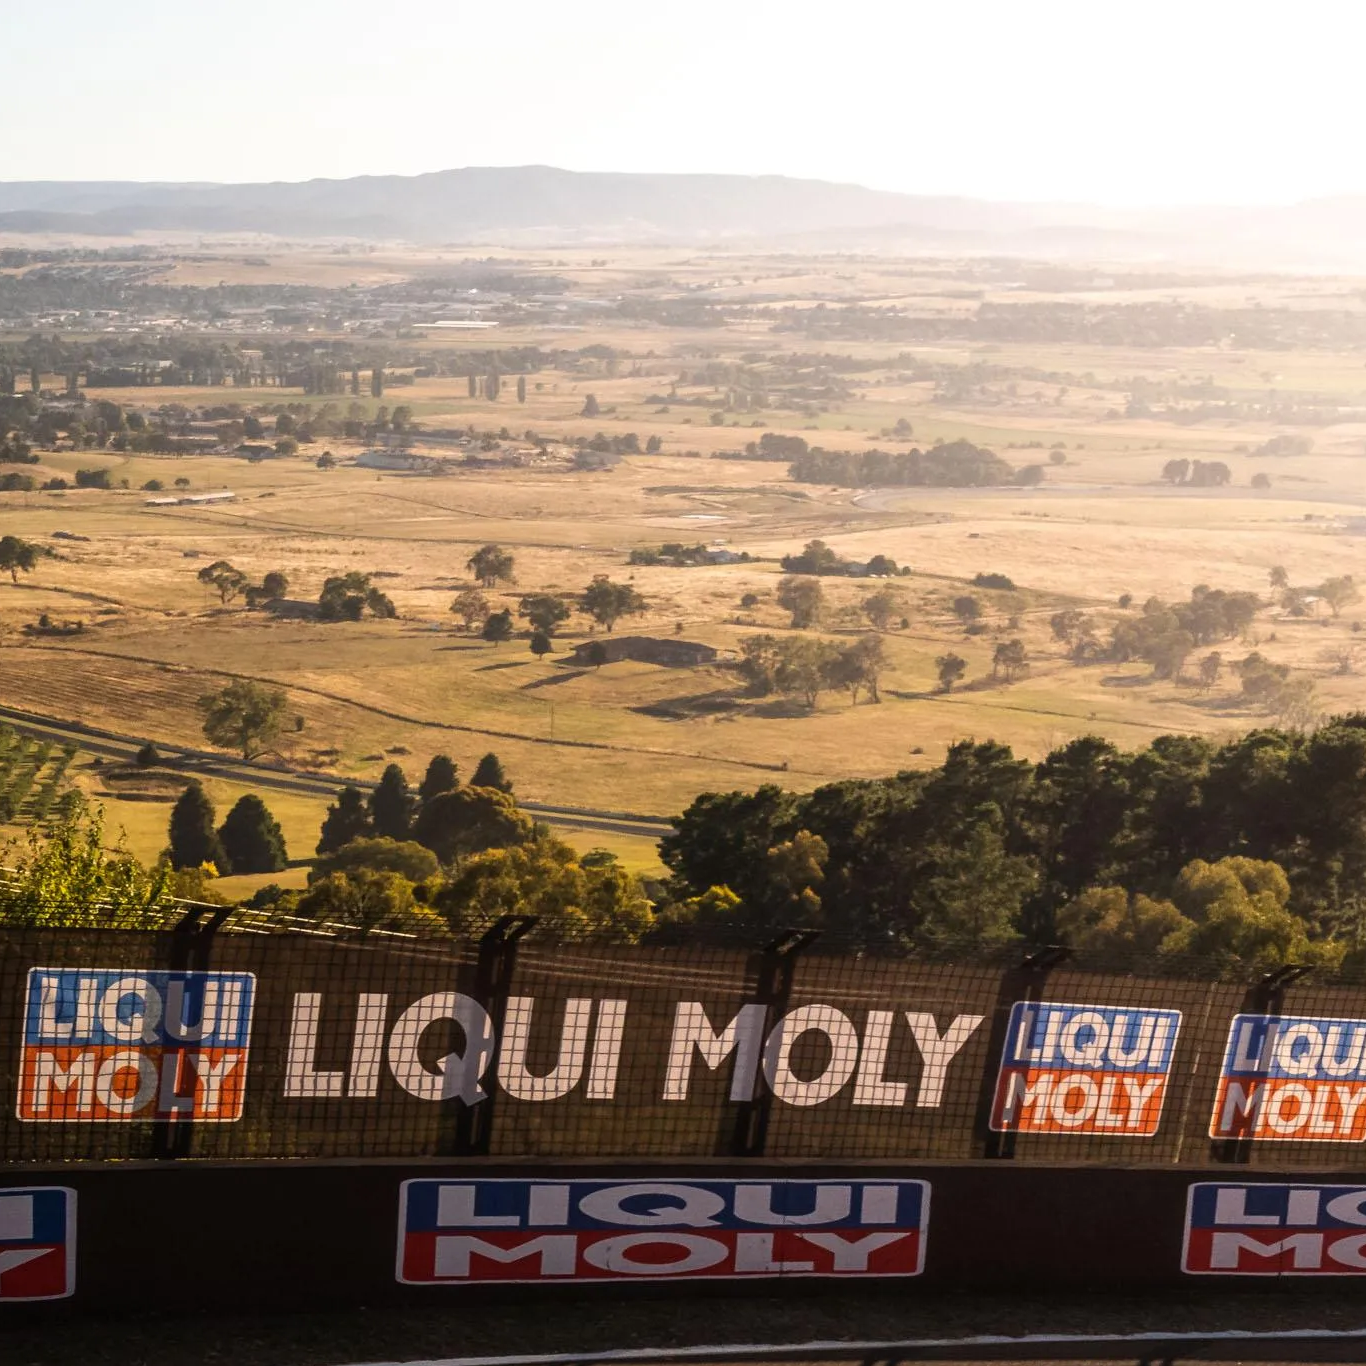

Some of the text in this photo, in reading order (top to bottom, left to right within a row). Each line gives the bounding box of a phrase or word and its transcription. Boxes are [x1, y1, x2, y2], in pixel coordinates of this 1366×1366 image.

[37, 977, 243, 1043] LIQUI
[1014, 1007, 1172, 1070] LIQUI
[283, 992, 986, 1107] LIQUI MOLY
[34, 1051, 243, 1114] MOLY
[1003, 1071, 1165, 1129] MOLY
[437, 1184, 900, 1228] LIQUI
[434, 1232, 913, 1278] MOLY
